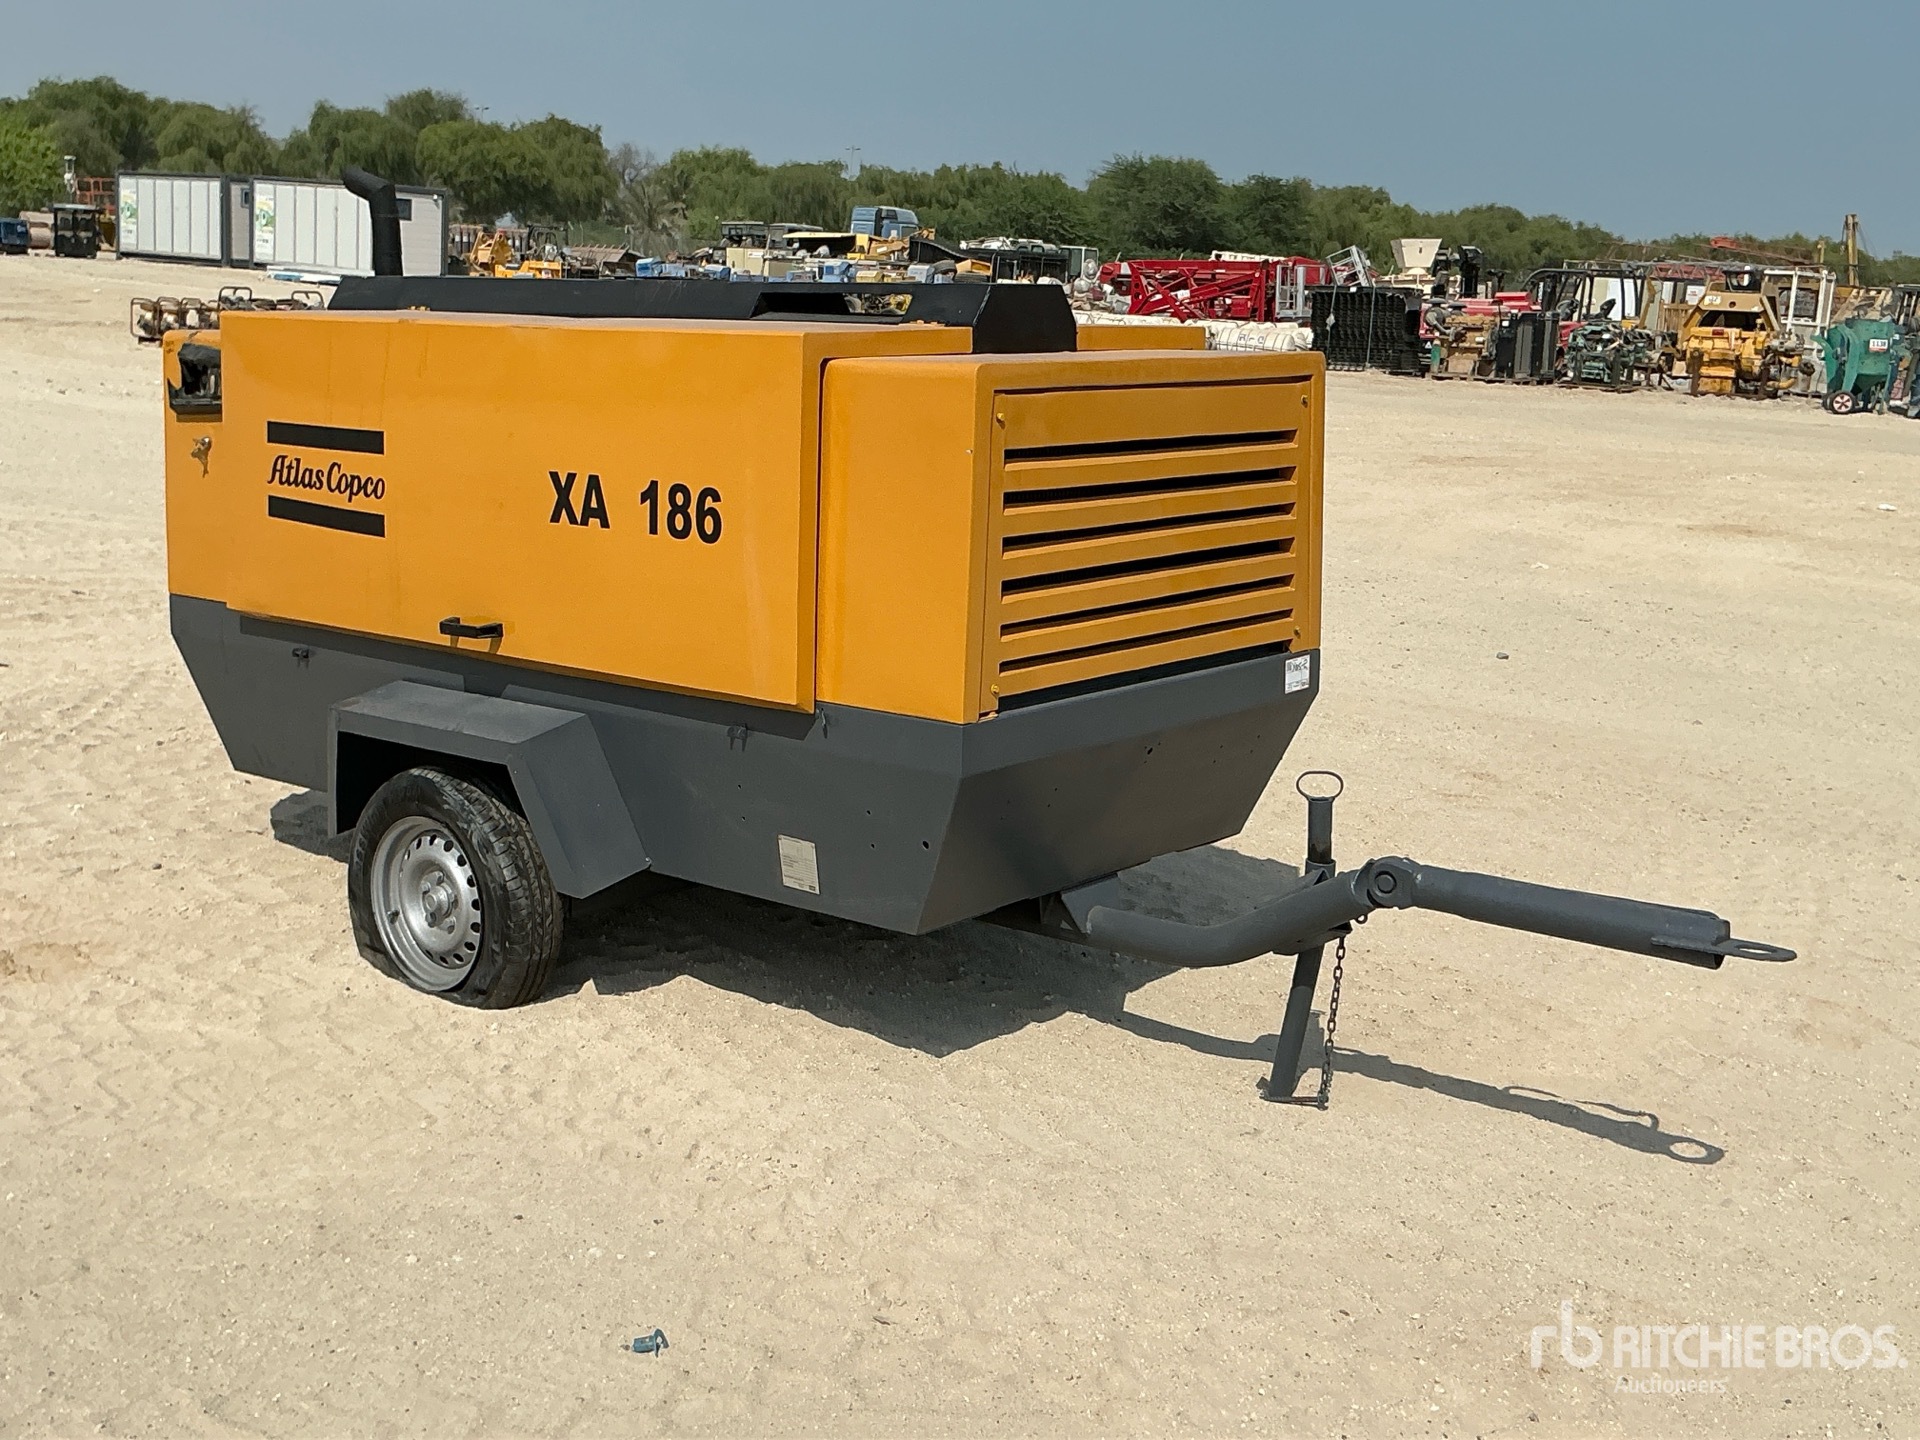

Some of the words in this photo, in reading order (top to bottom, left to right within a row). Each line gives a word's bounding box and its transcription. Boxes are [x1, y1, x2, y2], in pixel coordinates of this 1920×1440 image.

[267, 454, 325, 491] Atlas
[326, 461, 386, 503] Copco
[549, 471, 611, 529] XA
[640, 479, 722, 544] 186
